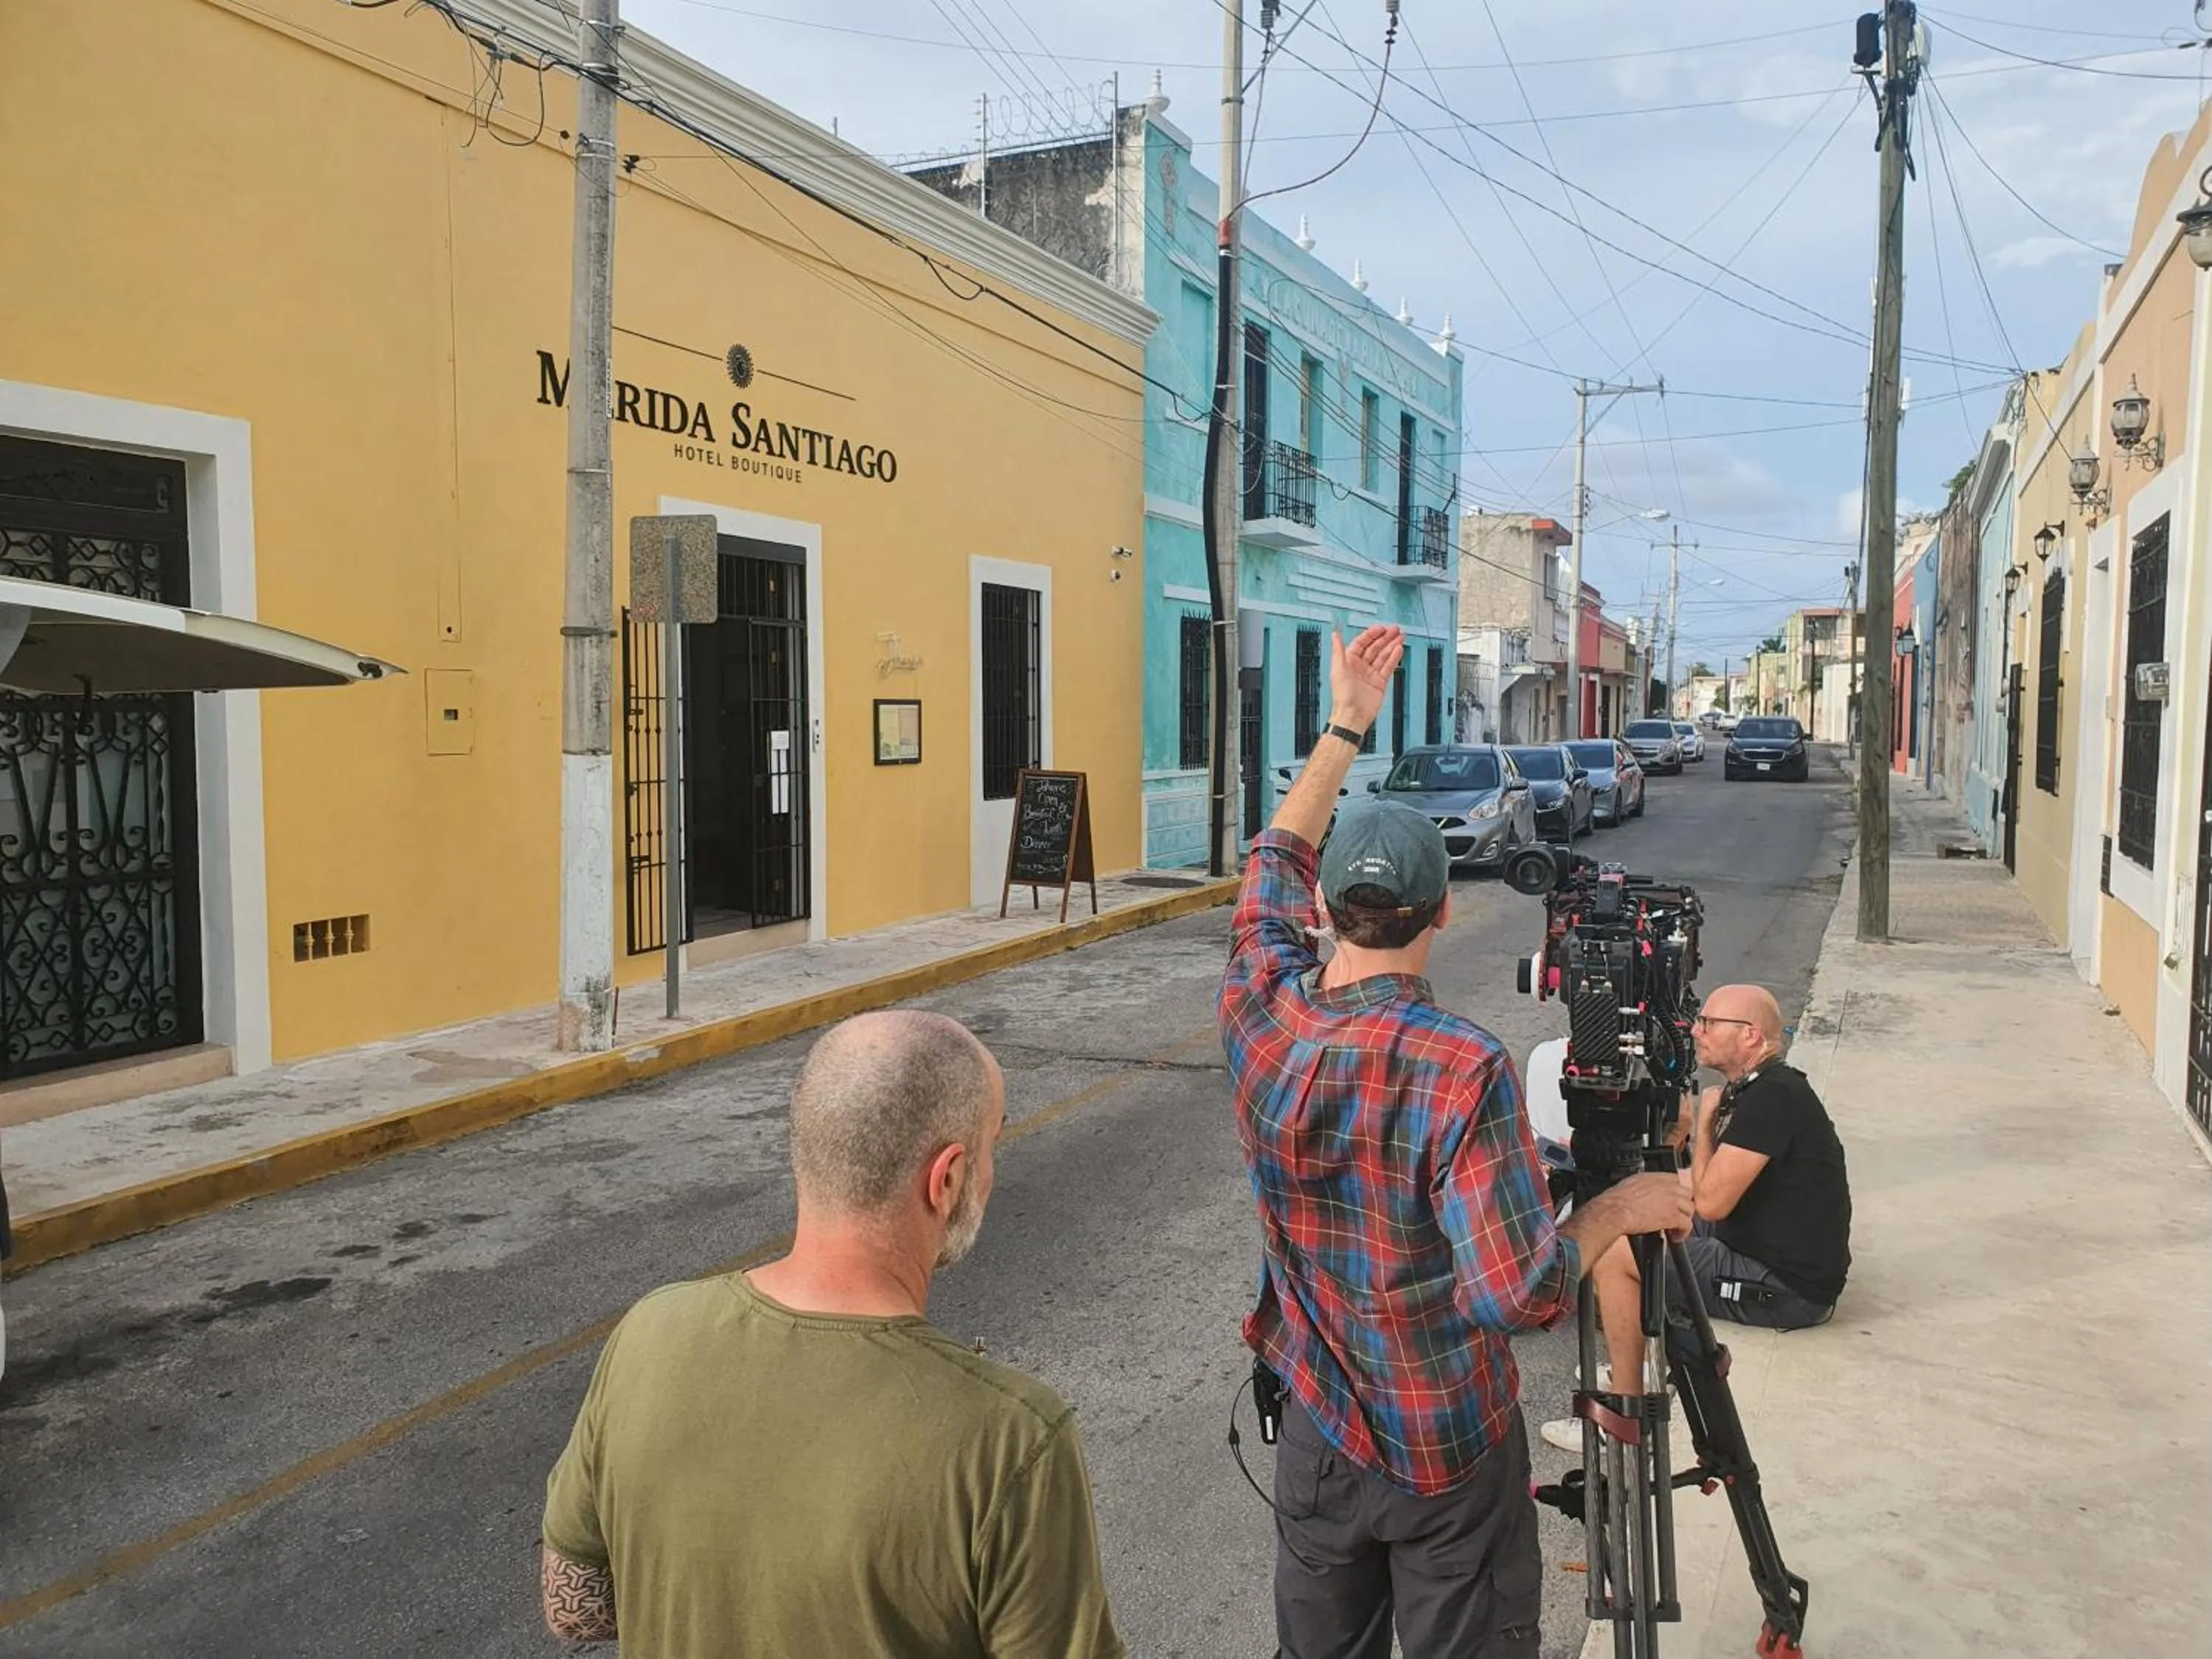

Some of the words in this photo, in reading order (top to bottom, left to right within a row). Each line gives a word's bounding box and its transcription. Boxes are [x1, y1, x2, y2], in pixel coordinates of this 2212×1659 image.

[536, 350, 716, 443] MRIDA
[731, 402, 897, 483] SANTIAGO
[674, 443, 723, 467] HOTEL
[731, 456, 802, 484] BOUTIQUE
